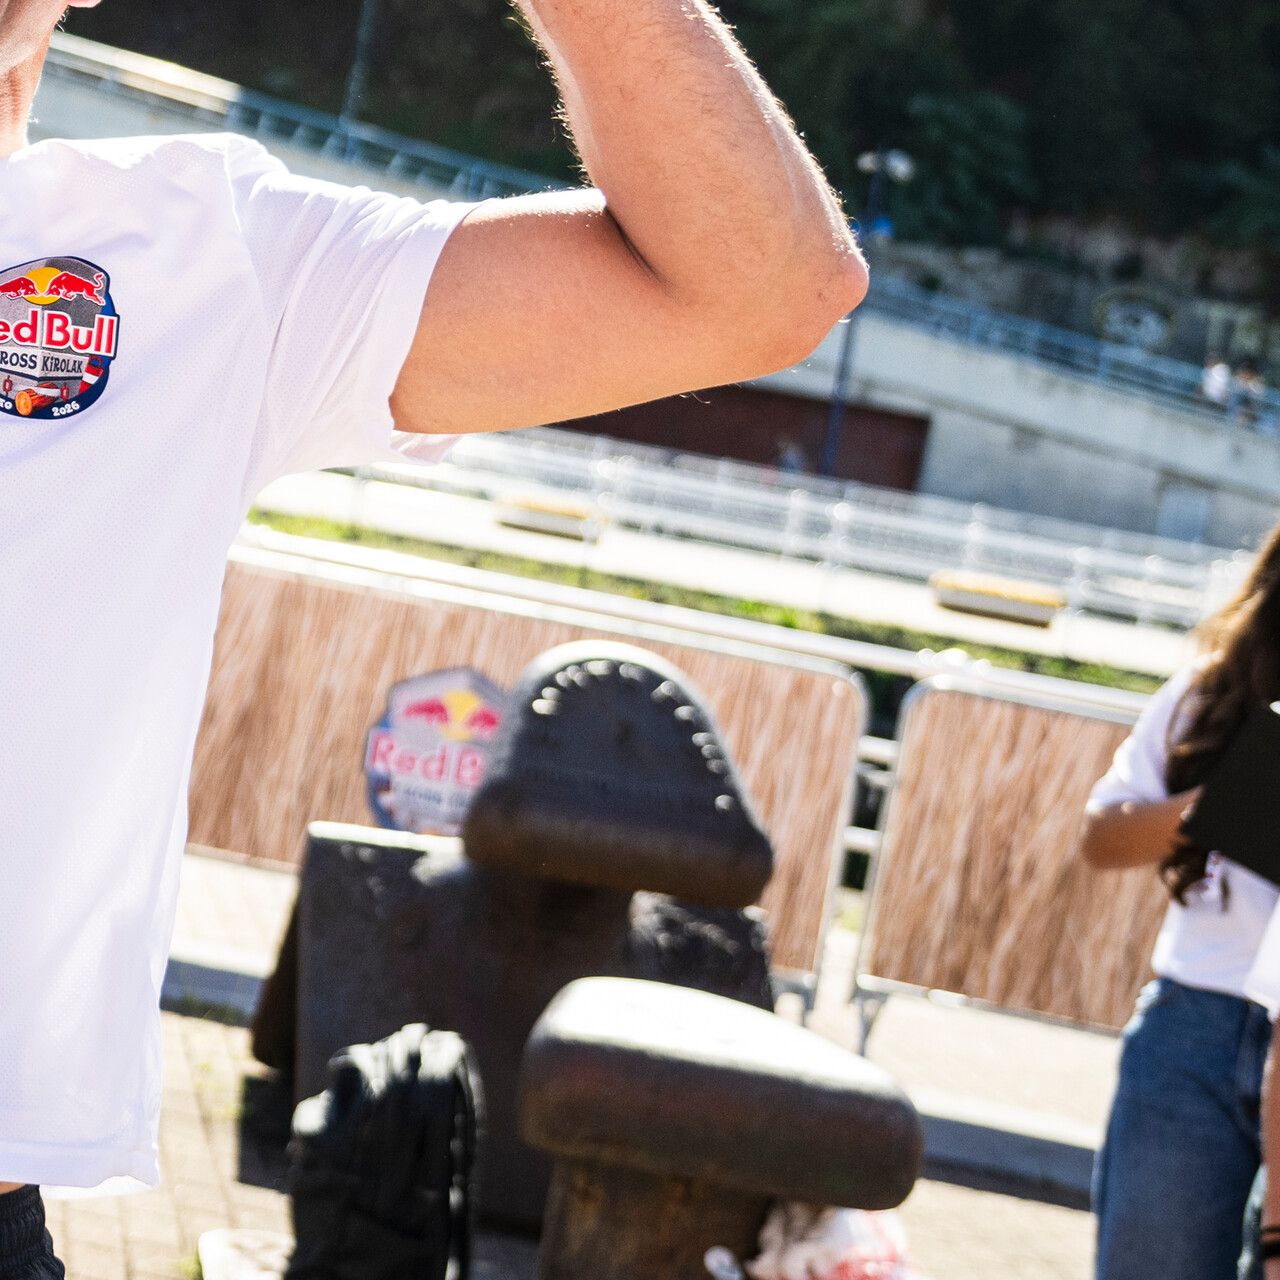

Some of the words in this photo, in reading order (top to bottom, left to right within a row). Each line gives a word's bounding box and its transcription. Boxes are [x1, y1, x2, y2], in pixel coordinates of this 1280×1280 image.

[43, 312, 115, 354] Bull
[51, 400, 81, 417] 2026
[371, 732, 448, 782] Red
